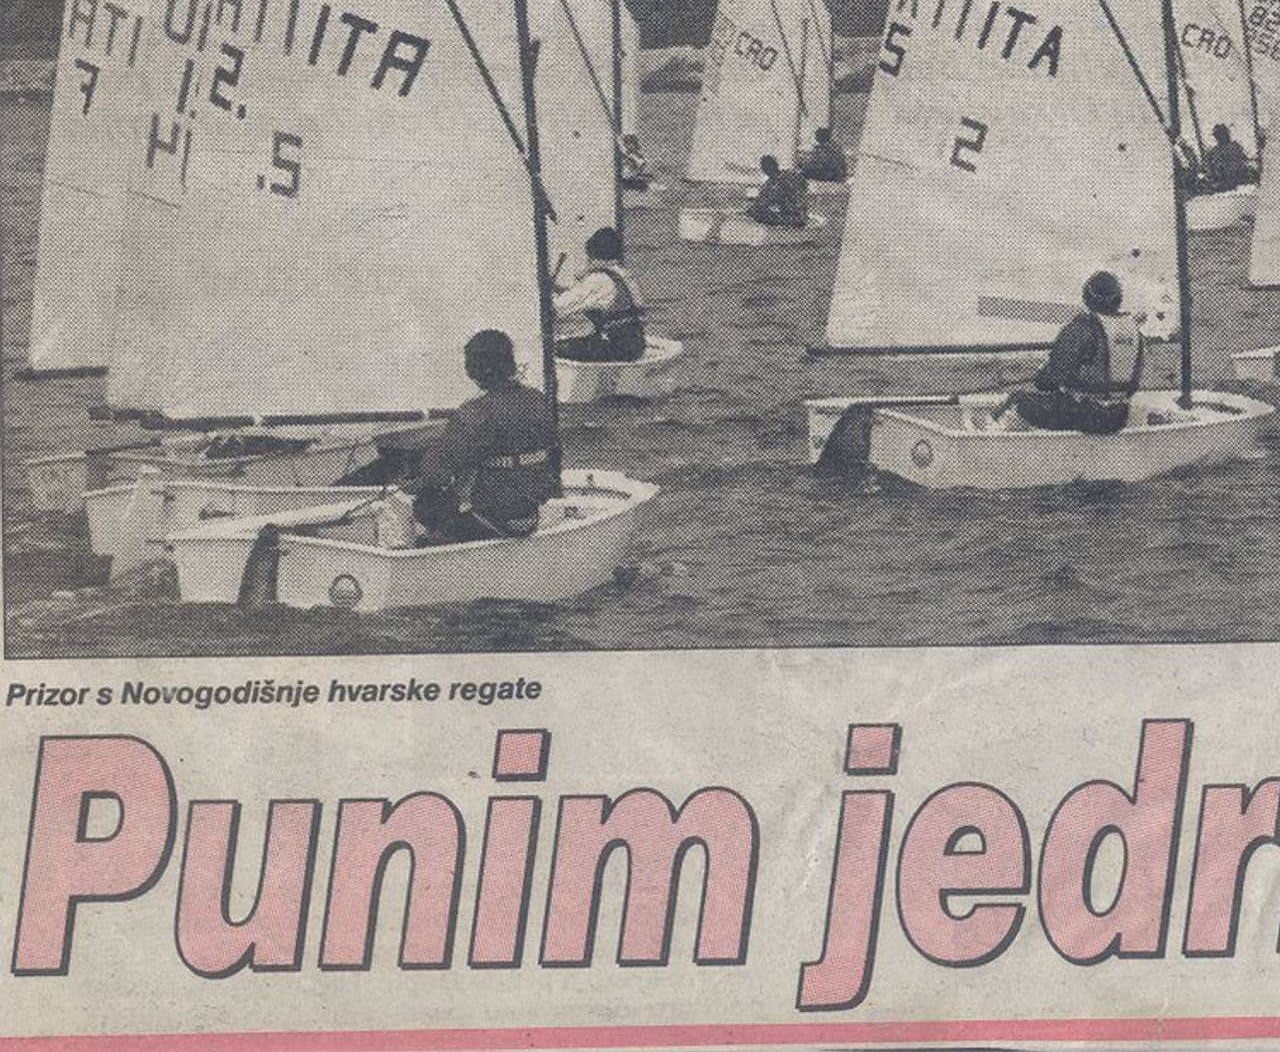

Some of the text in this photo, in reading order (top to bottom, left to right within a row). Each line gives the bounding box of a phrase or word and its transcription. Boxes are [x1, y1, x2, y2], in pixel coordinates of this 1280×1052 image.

[5, 677, 542, 709] Prizor s Novogodišnje hvarske regate
[11, 728, 760, 980] Punim
